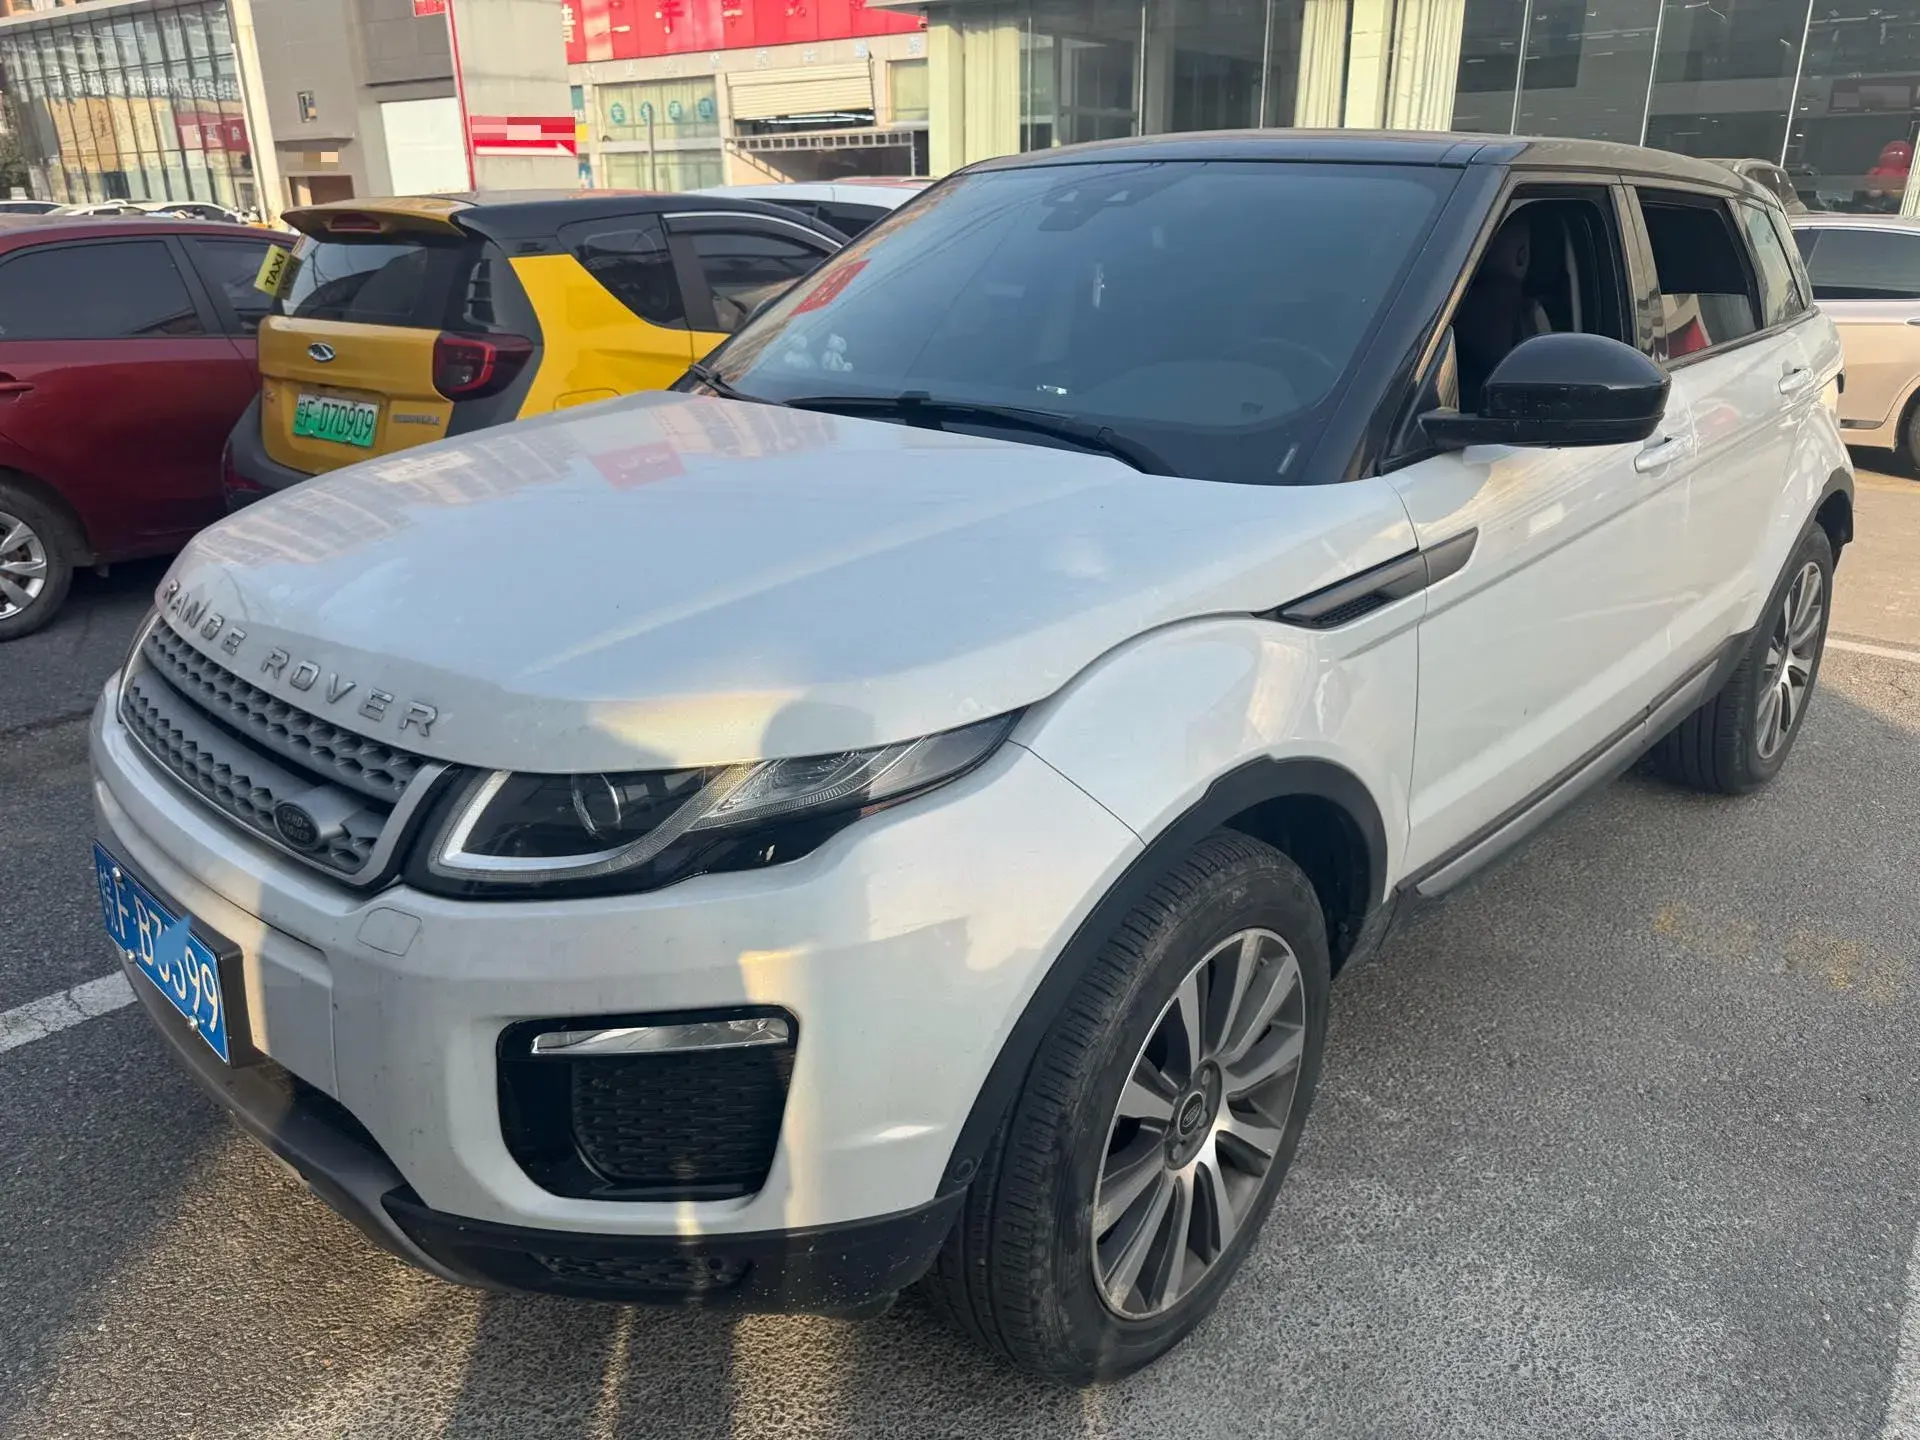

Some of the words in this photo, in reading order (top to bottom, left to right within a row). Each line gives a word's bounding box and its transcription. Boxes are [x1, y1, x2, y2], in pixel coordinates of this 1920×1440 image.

[264, 252, 286, 286] TAXI
[161, 577, 248, 656] RANGE
[260, 647, 439, 738] ROVER
